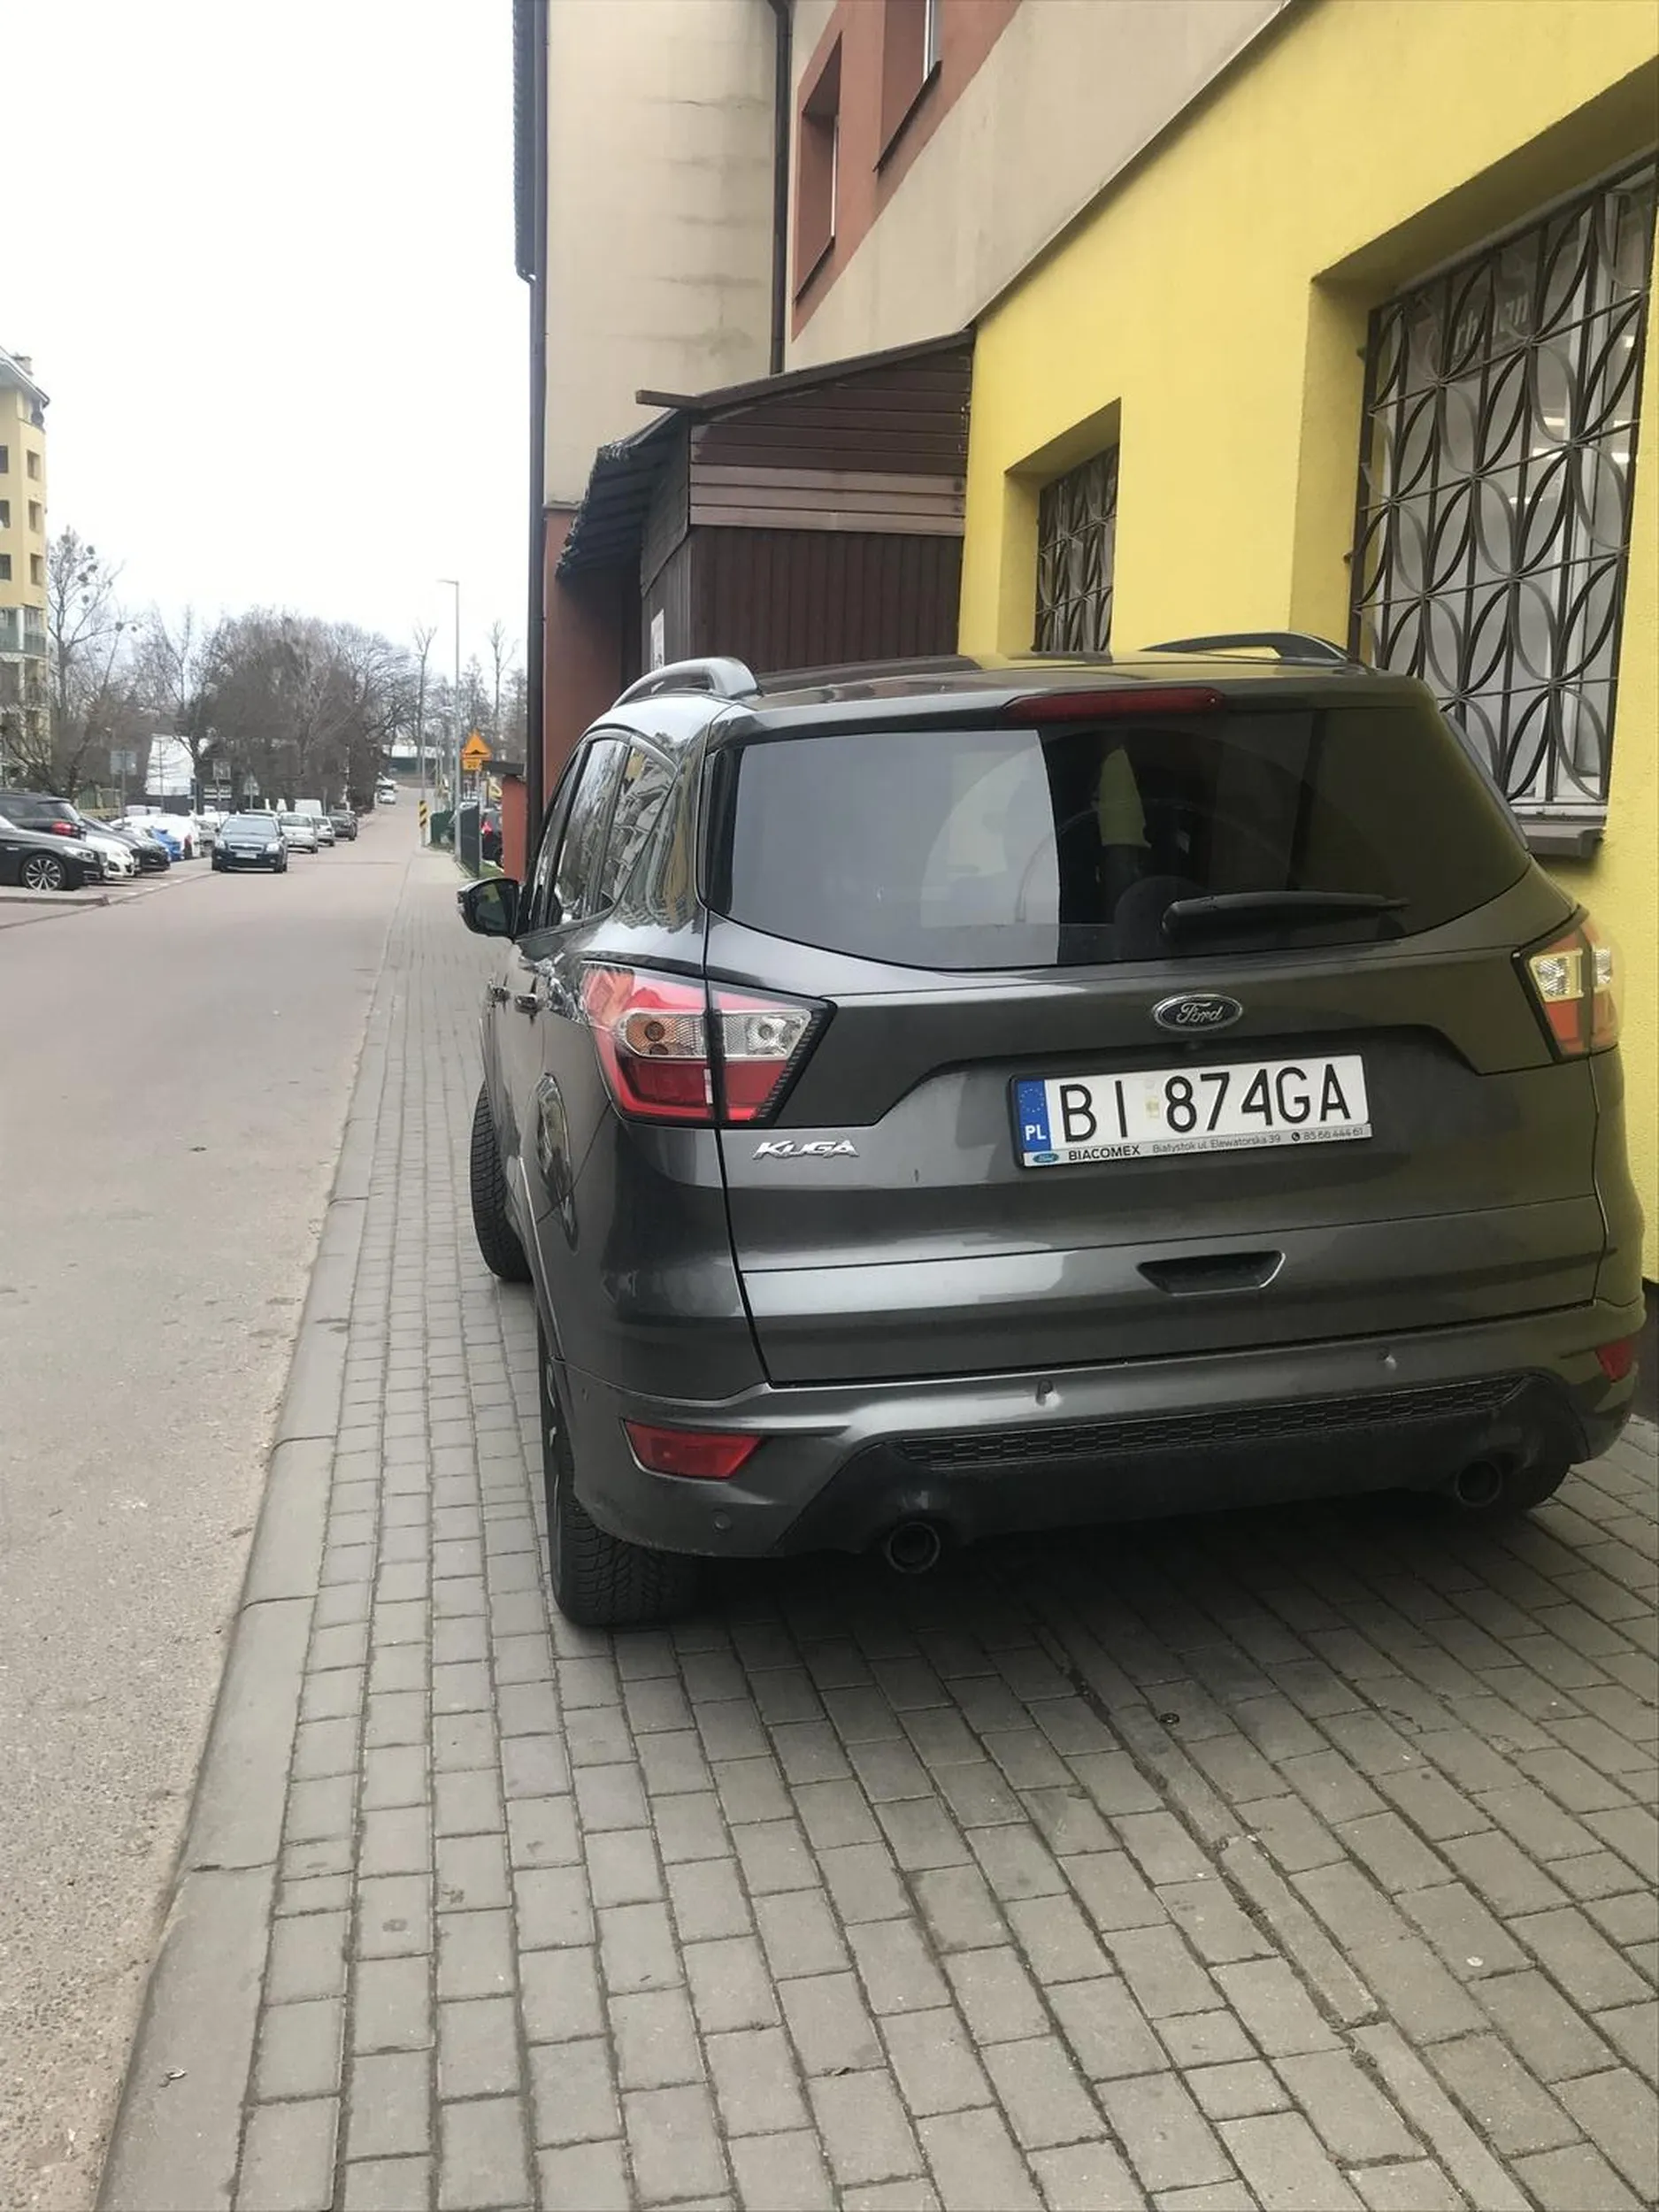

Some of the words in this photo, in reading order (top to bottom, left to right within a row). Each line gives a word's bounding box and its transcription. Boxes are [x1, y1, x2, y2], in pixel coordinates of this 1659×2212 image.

[1176, 1002, 1224, 1023] Ford
[1059, 1080, 1128, 1142] BI
[1164, 1064, 1352, 1133] 874GA
[1025, 1125, 1047, 1141] PL
[752, 1140, 860, 1160] KUGA
[1068, 1145, 1141, 1161] BIACOMEX
